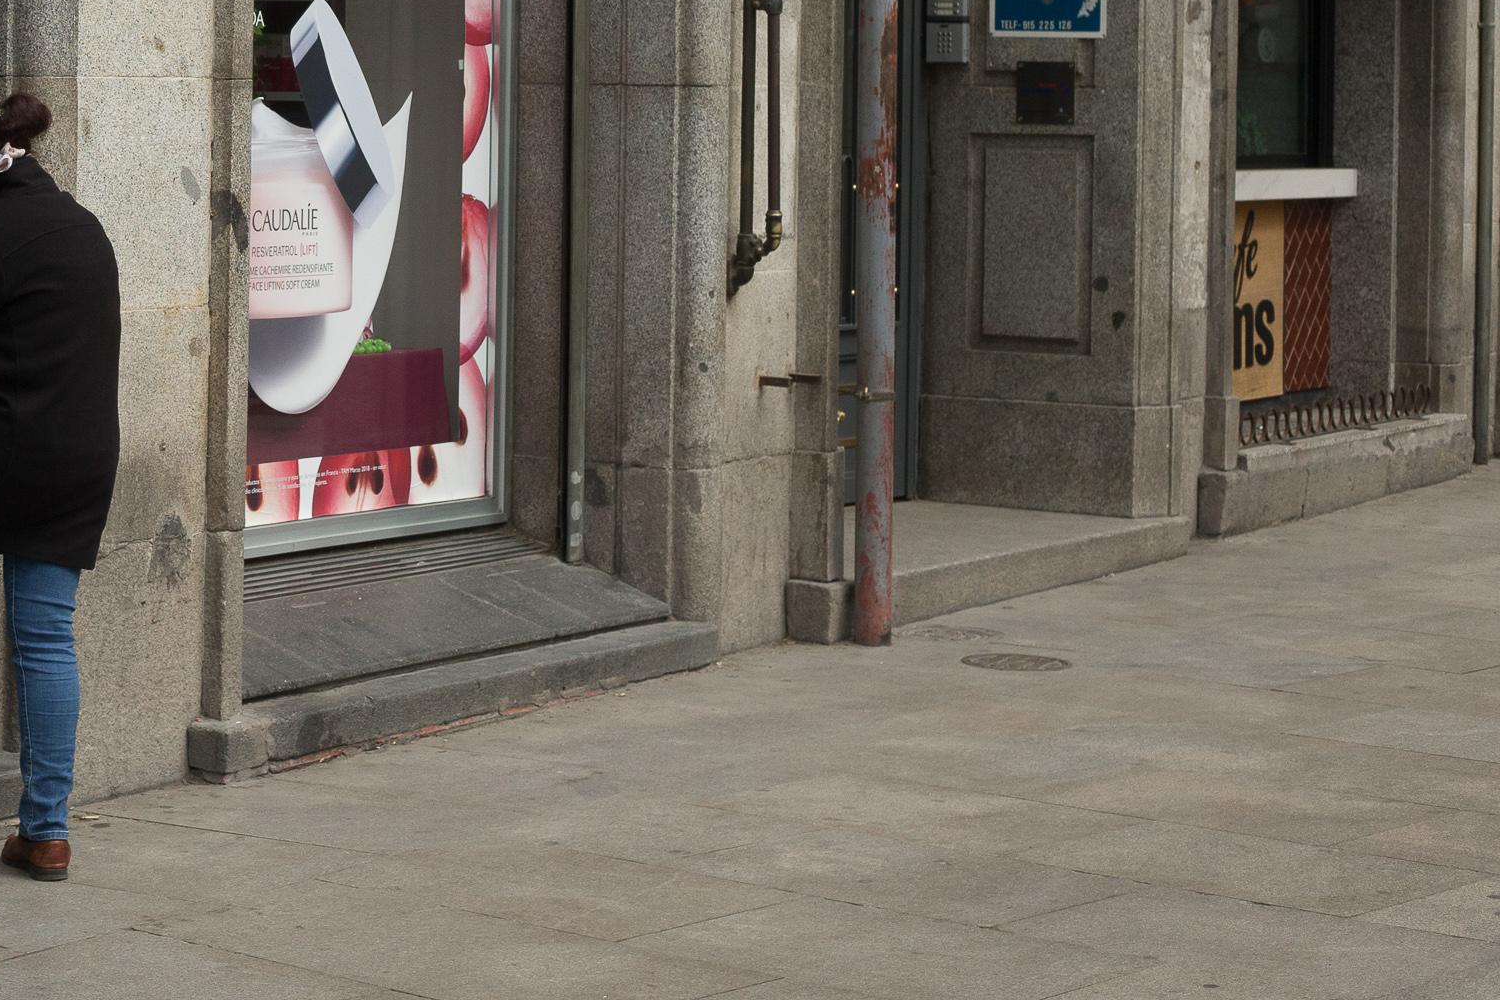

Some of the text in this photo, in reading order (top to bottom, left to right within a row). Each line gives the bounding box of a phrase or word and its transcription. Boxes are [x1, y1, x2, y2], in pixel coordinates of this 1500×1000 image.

[252, 10, 265, 27] A
[251, 245, 298, 258] RESVERATROL
[263, 281, 285, 291] LIFTING
[285, 280, 300, 290] SOFT
[300, 279, 320, 289] CREAM
